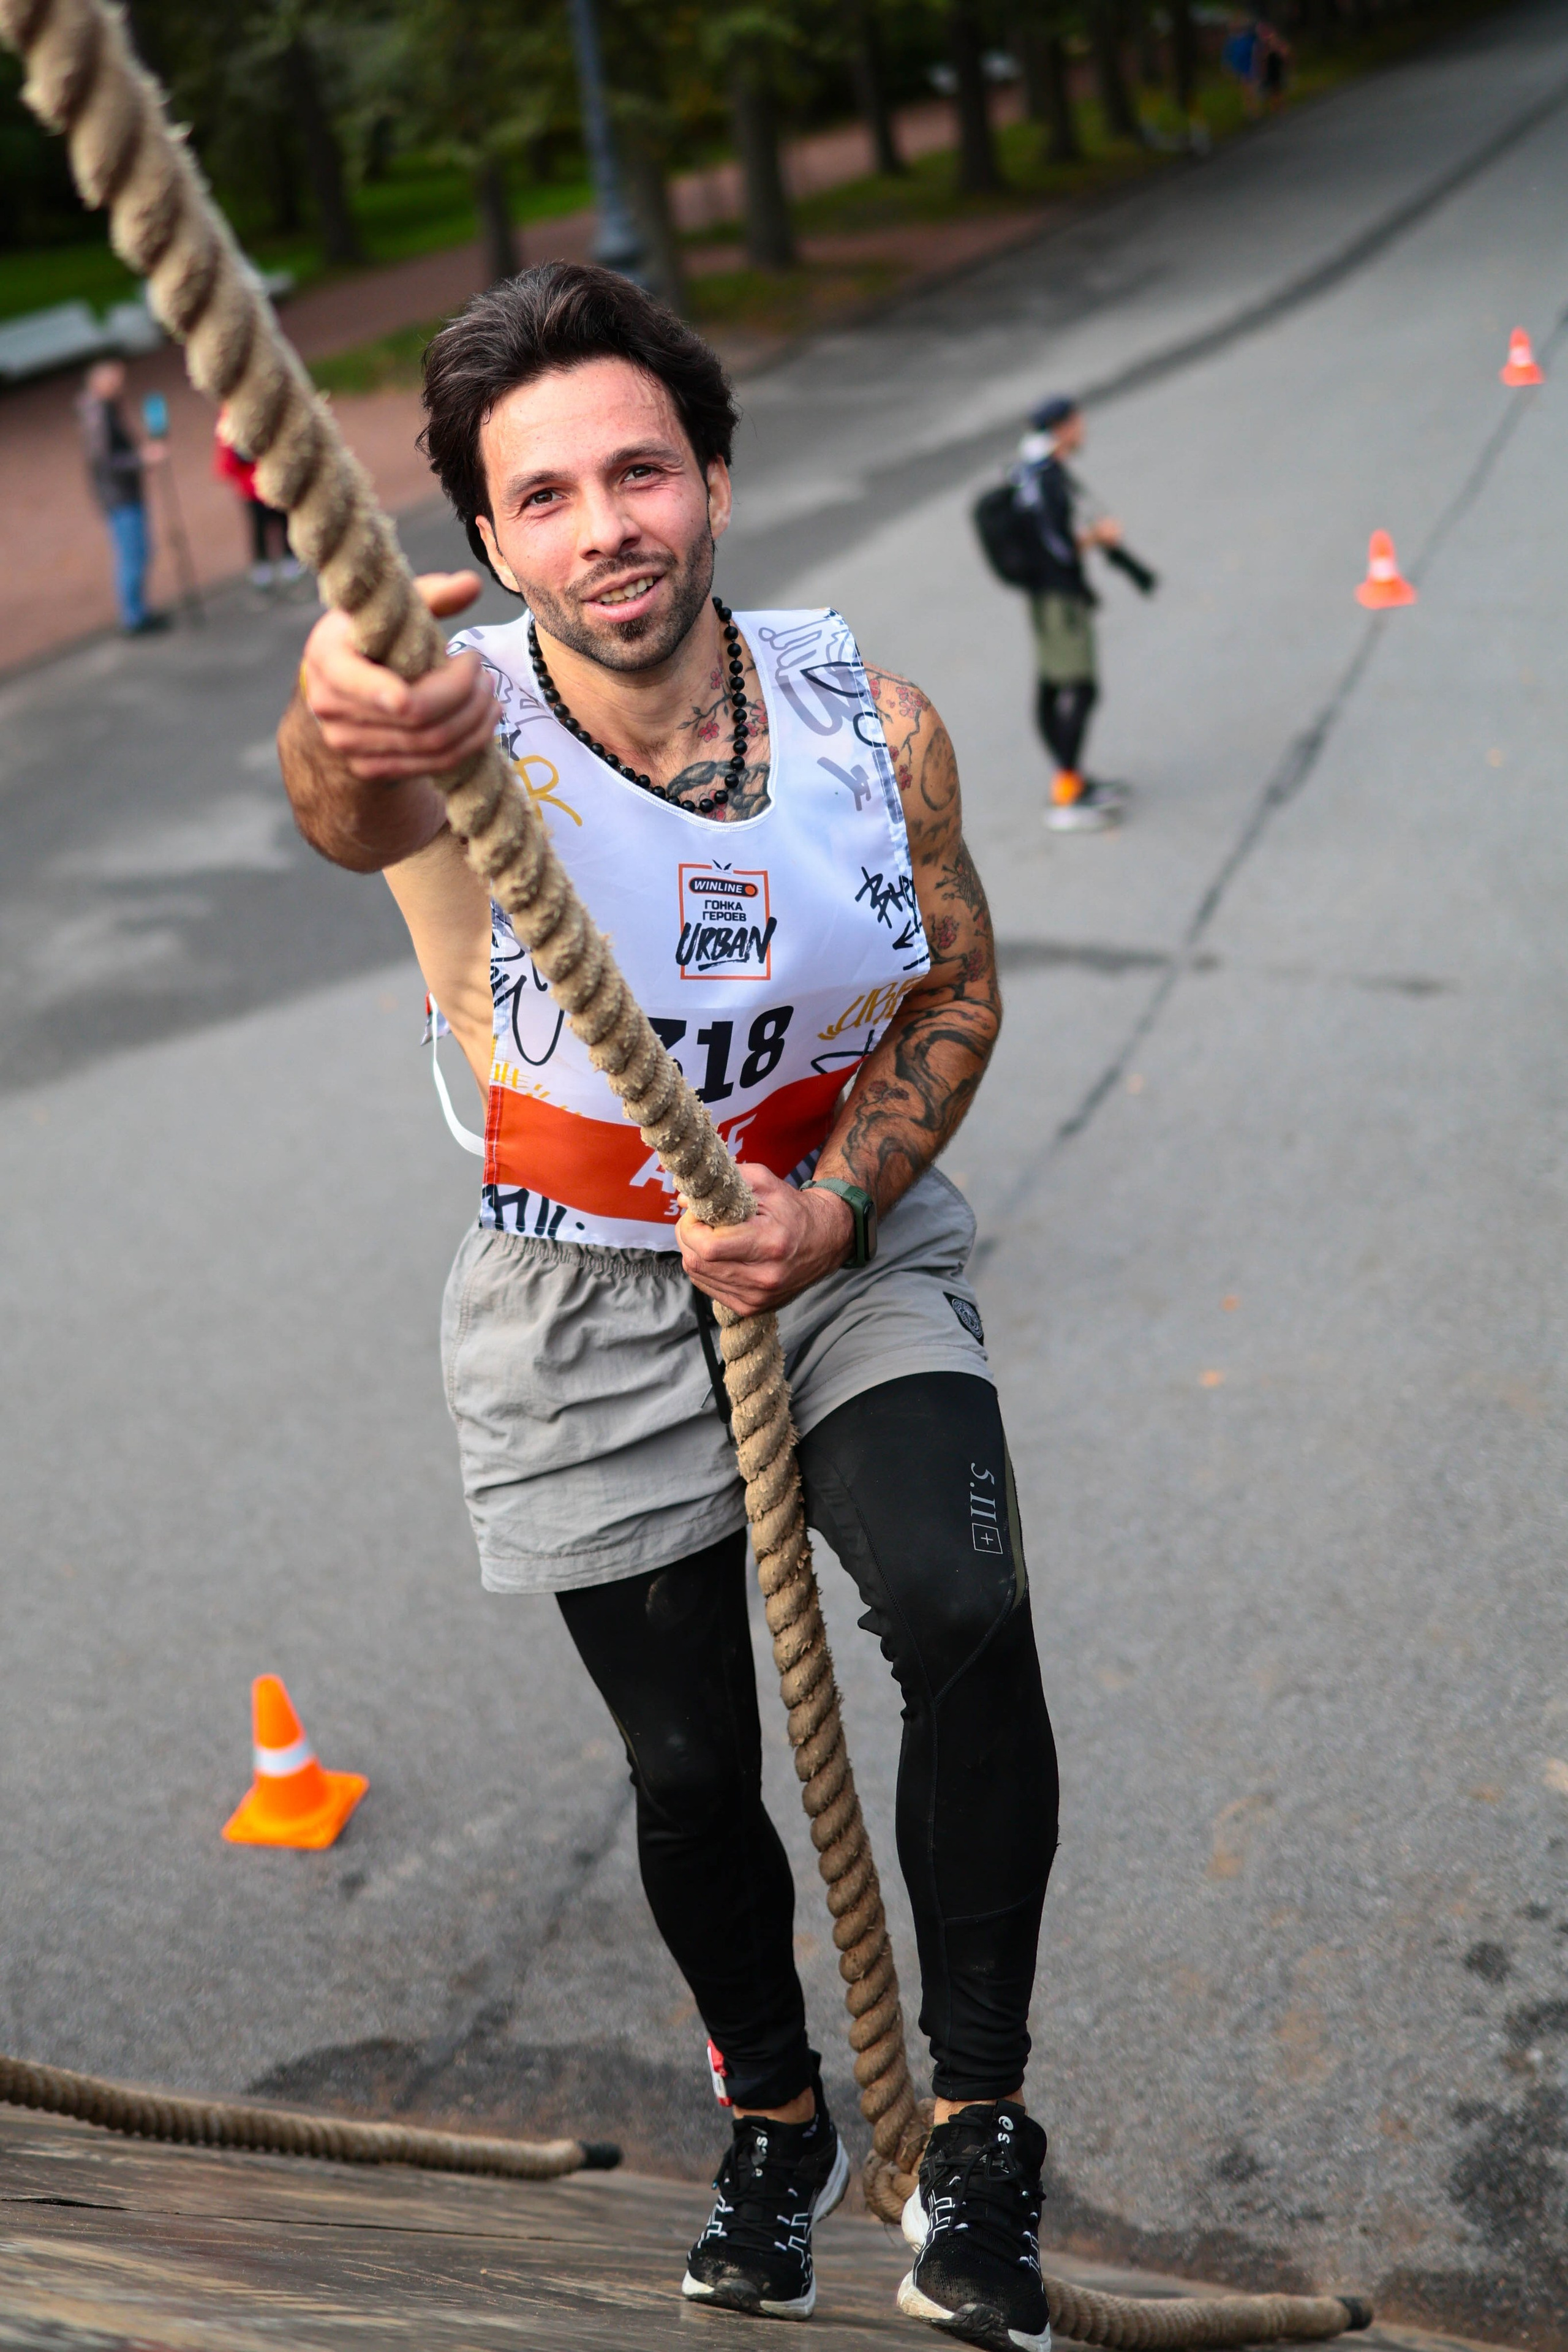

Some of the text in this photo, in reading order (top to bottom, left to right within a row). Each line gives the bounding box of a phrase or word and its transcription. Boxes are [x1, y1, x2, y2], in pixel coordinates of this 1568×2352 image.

[694, 881, 742, 894] WINLINE
[704, 900, 743, 911] ГОНКА
[703, 911, 747, 922] ГЕРОЕВ
[675, 916, 777, 967] URBAN
